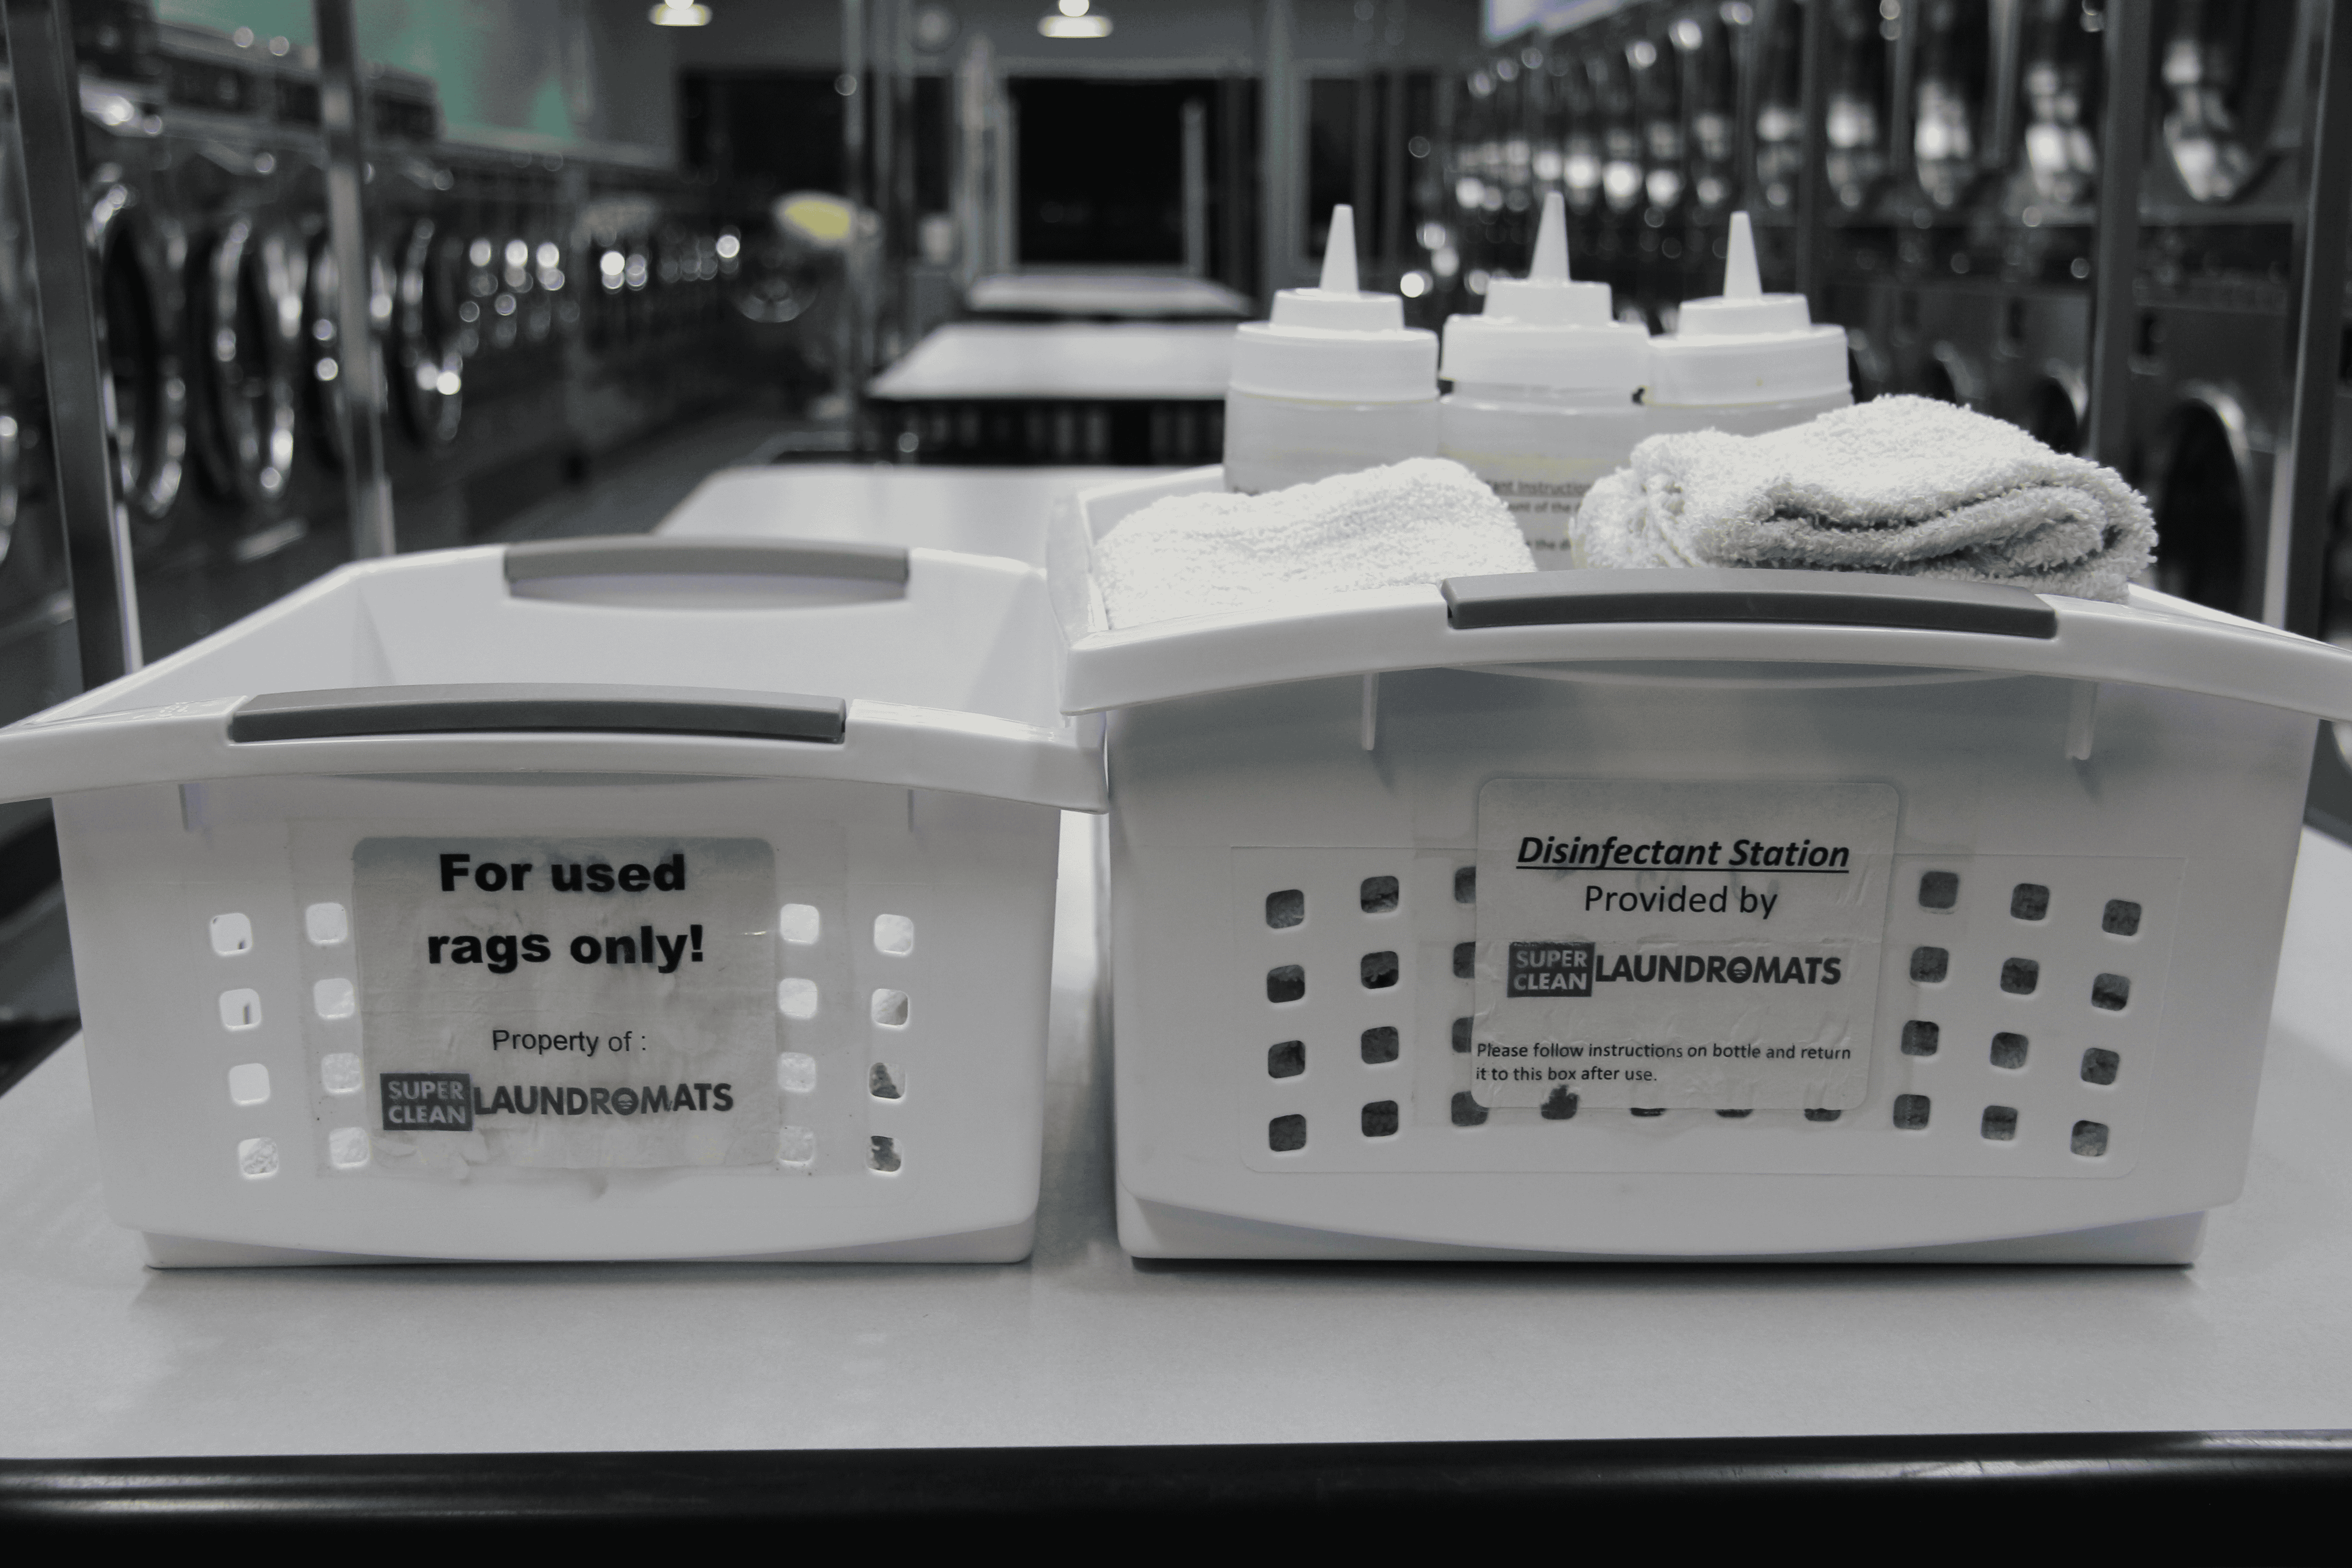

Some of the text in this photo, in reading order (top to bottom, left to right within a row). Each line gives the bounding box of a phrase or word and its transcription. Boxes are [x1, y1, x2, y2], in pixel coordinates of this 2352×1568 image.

[1518, 836, 1849, 868] Disinfectant Station
[440, 853, 686, 893] For used
[1585, 885, 1778, 920] Provided by
[428, 924, 703, 974] rags only!
[1516, 950, 1588, 968] SUPER
[1514, 973, 1587, 990] CLEAN
[1595, 955, 1841, 985] LAUNDROMATS
[492, 1029, 599, 1057] Property
[608, 1030, 633, 1052] of
[1477, 1043, 1851, 1060] Please follow instructions on bottle and return
[1476, 1066, 1657, 1082] it to this box after use.
[388, 1081, 464, 1100] SUPER
[473, 1083, 734, 1116] LAUNDROMATS
[388, 1105, 465, 1123] CLEAN
